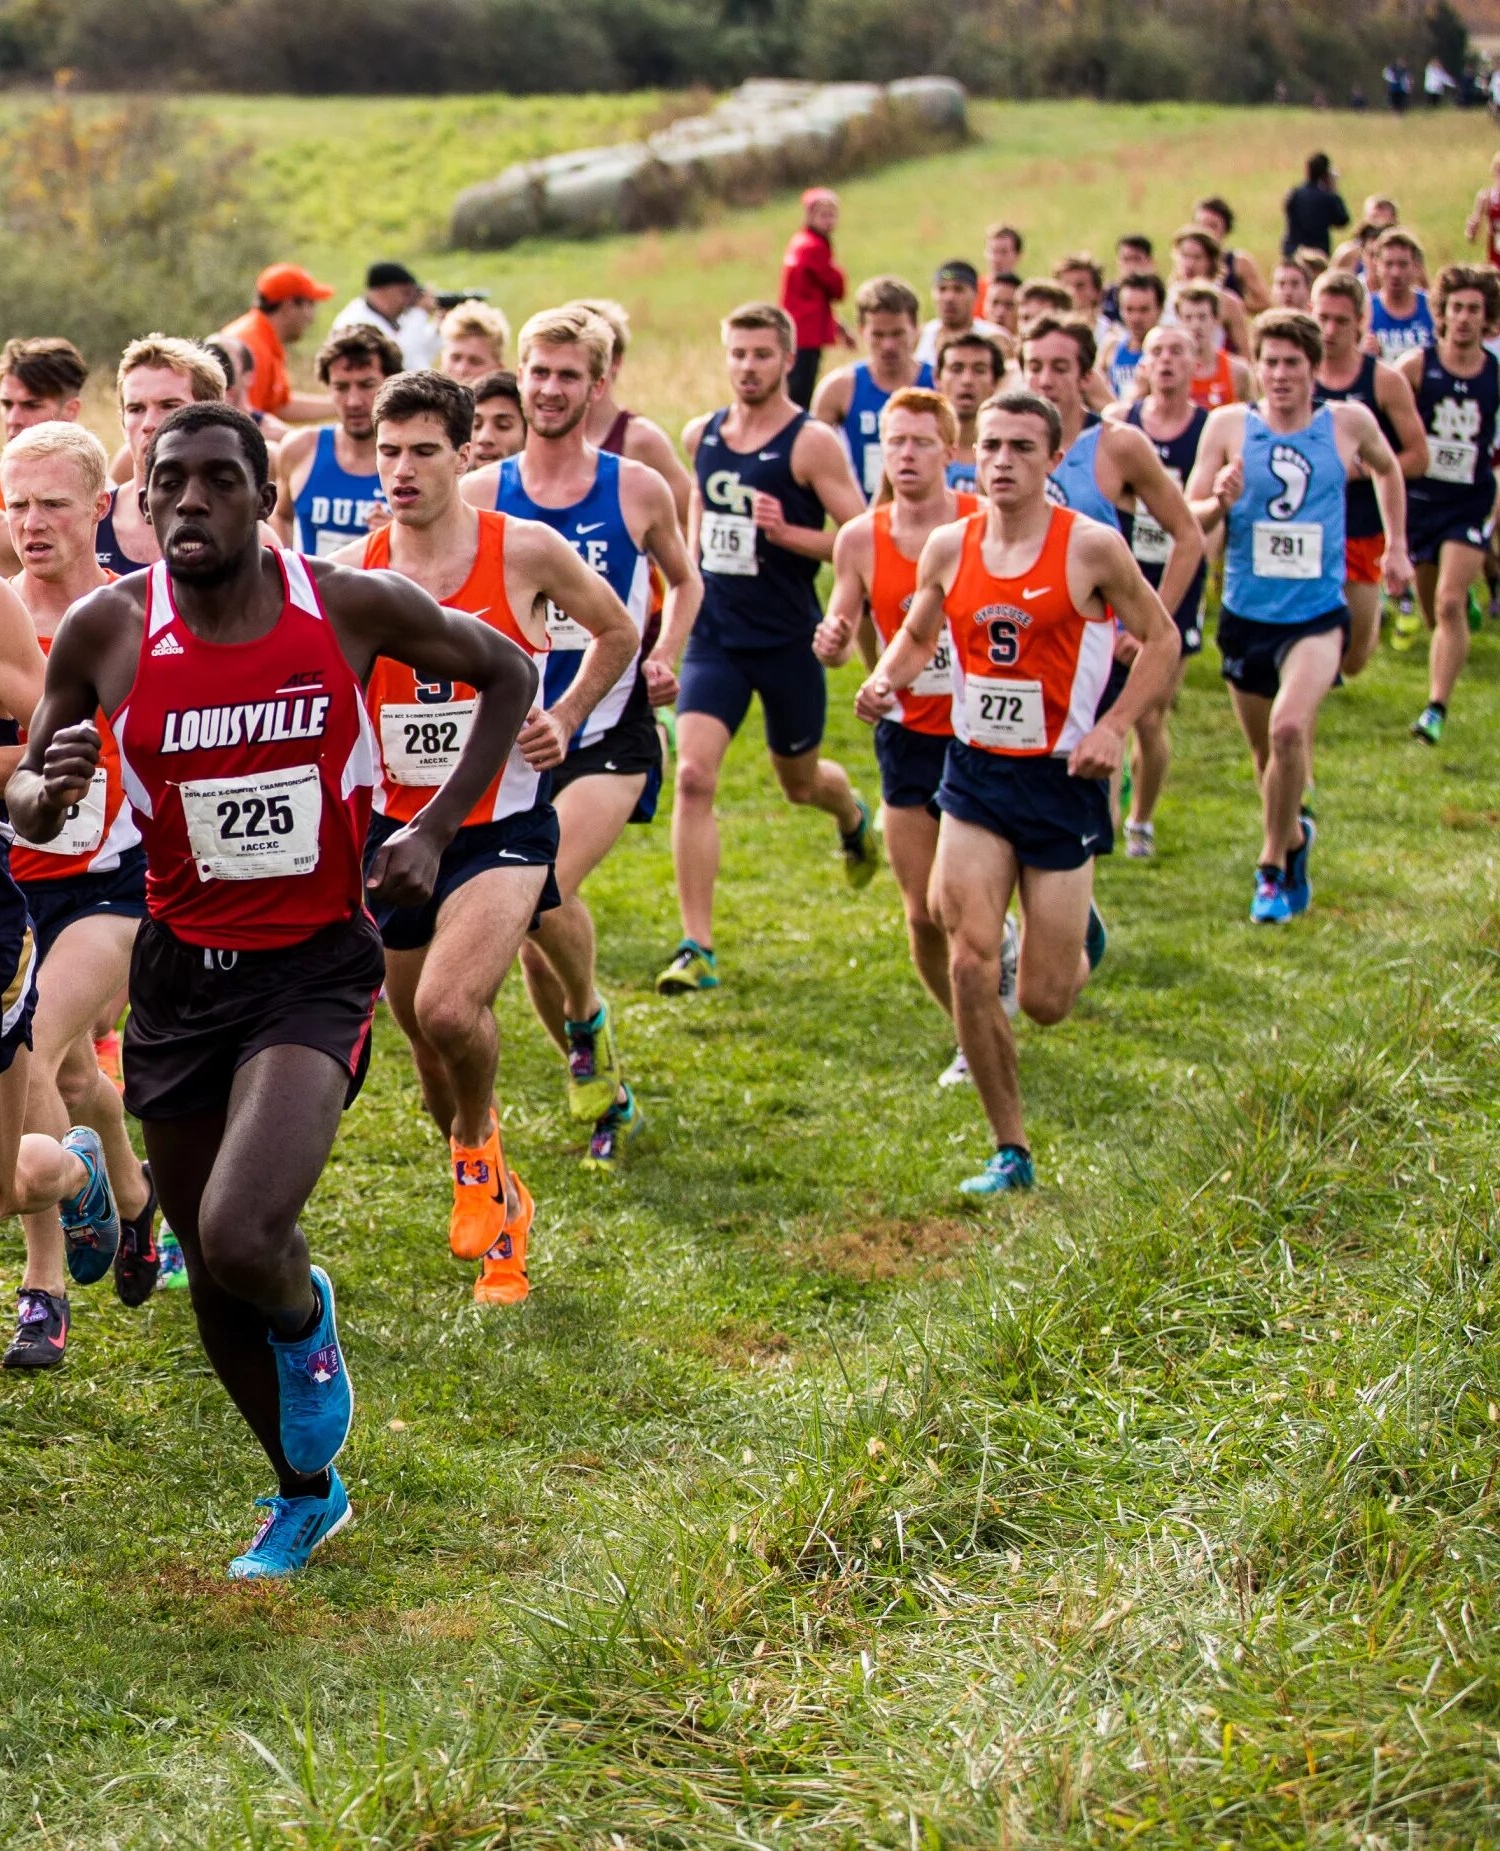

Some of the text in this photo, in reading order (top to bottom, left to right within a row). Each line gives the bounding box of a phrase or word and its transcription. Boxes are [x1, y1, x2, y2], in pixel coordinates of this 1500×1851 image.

[1270, 535, 1303, 556] 291
[151, 646, 184, 657] adidas
[988, 618, 1019, 666] S
[282, 671, 325, 688] ACC
[981, 694, 1024, 722] 272
[159, 695, 332, 755] LOUISVILLE
[404, 721, 460, 754] 282
[217, 795, 294, 839] 225
